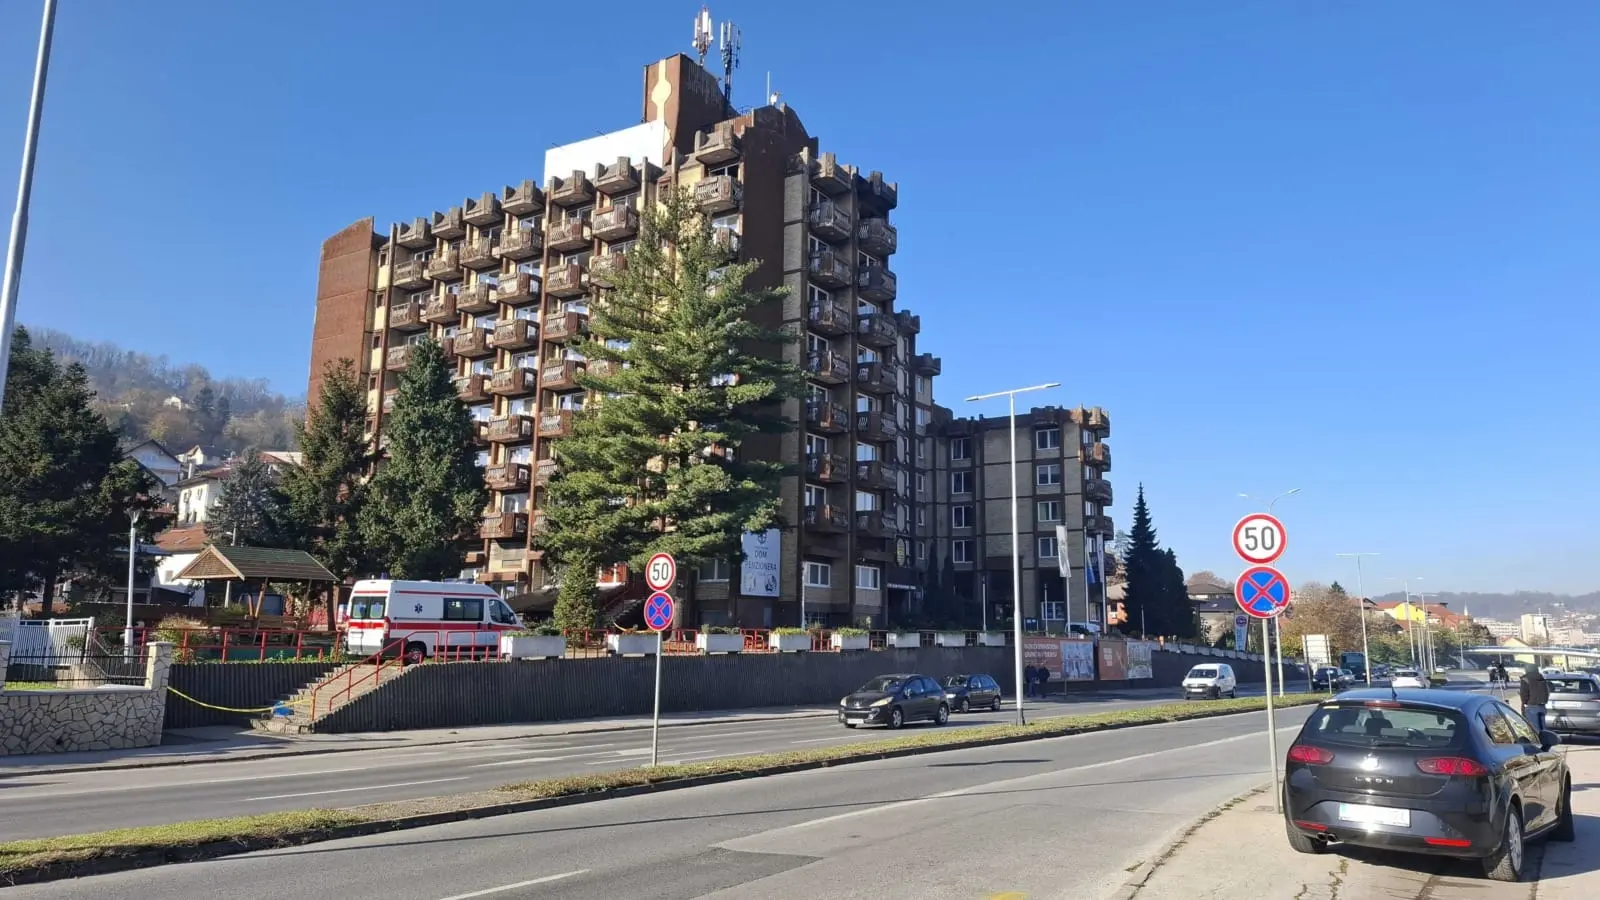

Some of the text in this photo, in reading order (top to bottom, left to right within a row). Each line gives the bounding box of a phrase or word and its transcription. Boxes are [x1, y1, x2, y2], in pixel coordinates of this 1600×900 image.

[1245, 526, 1275, 551] 50
[754, 550, 768, 559] DOM
[652, 562, 669, 581] 50
[744, 561, 777, 571] PENZIONERA
